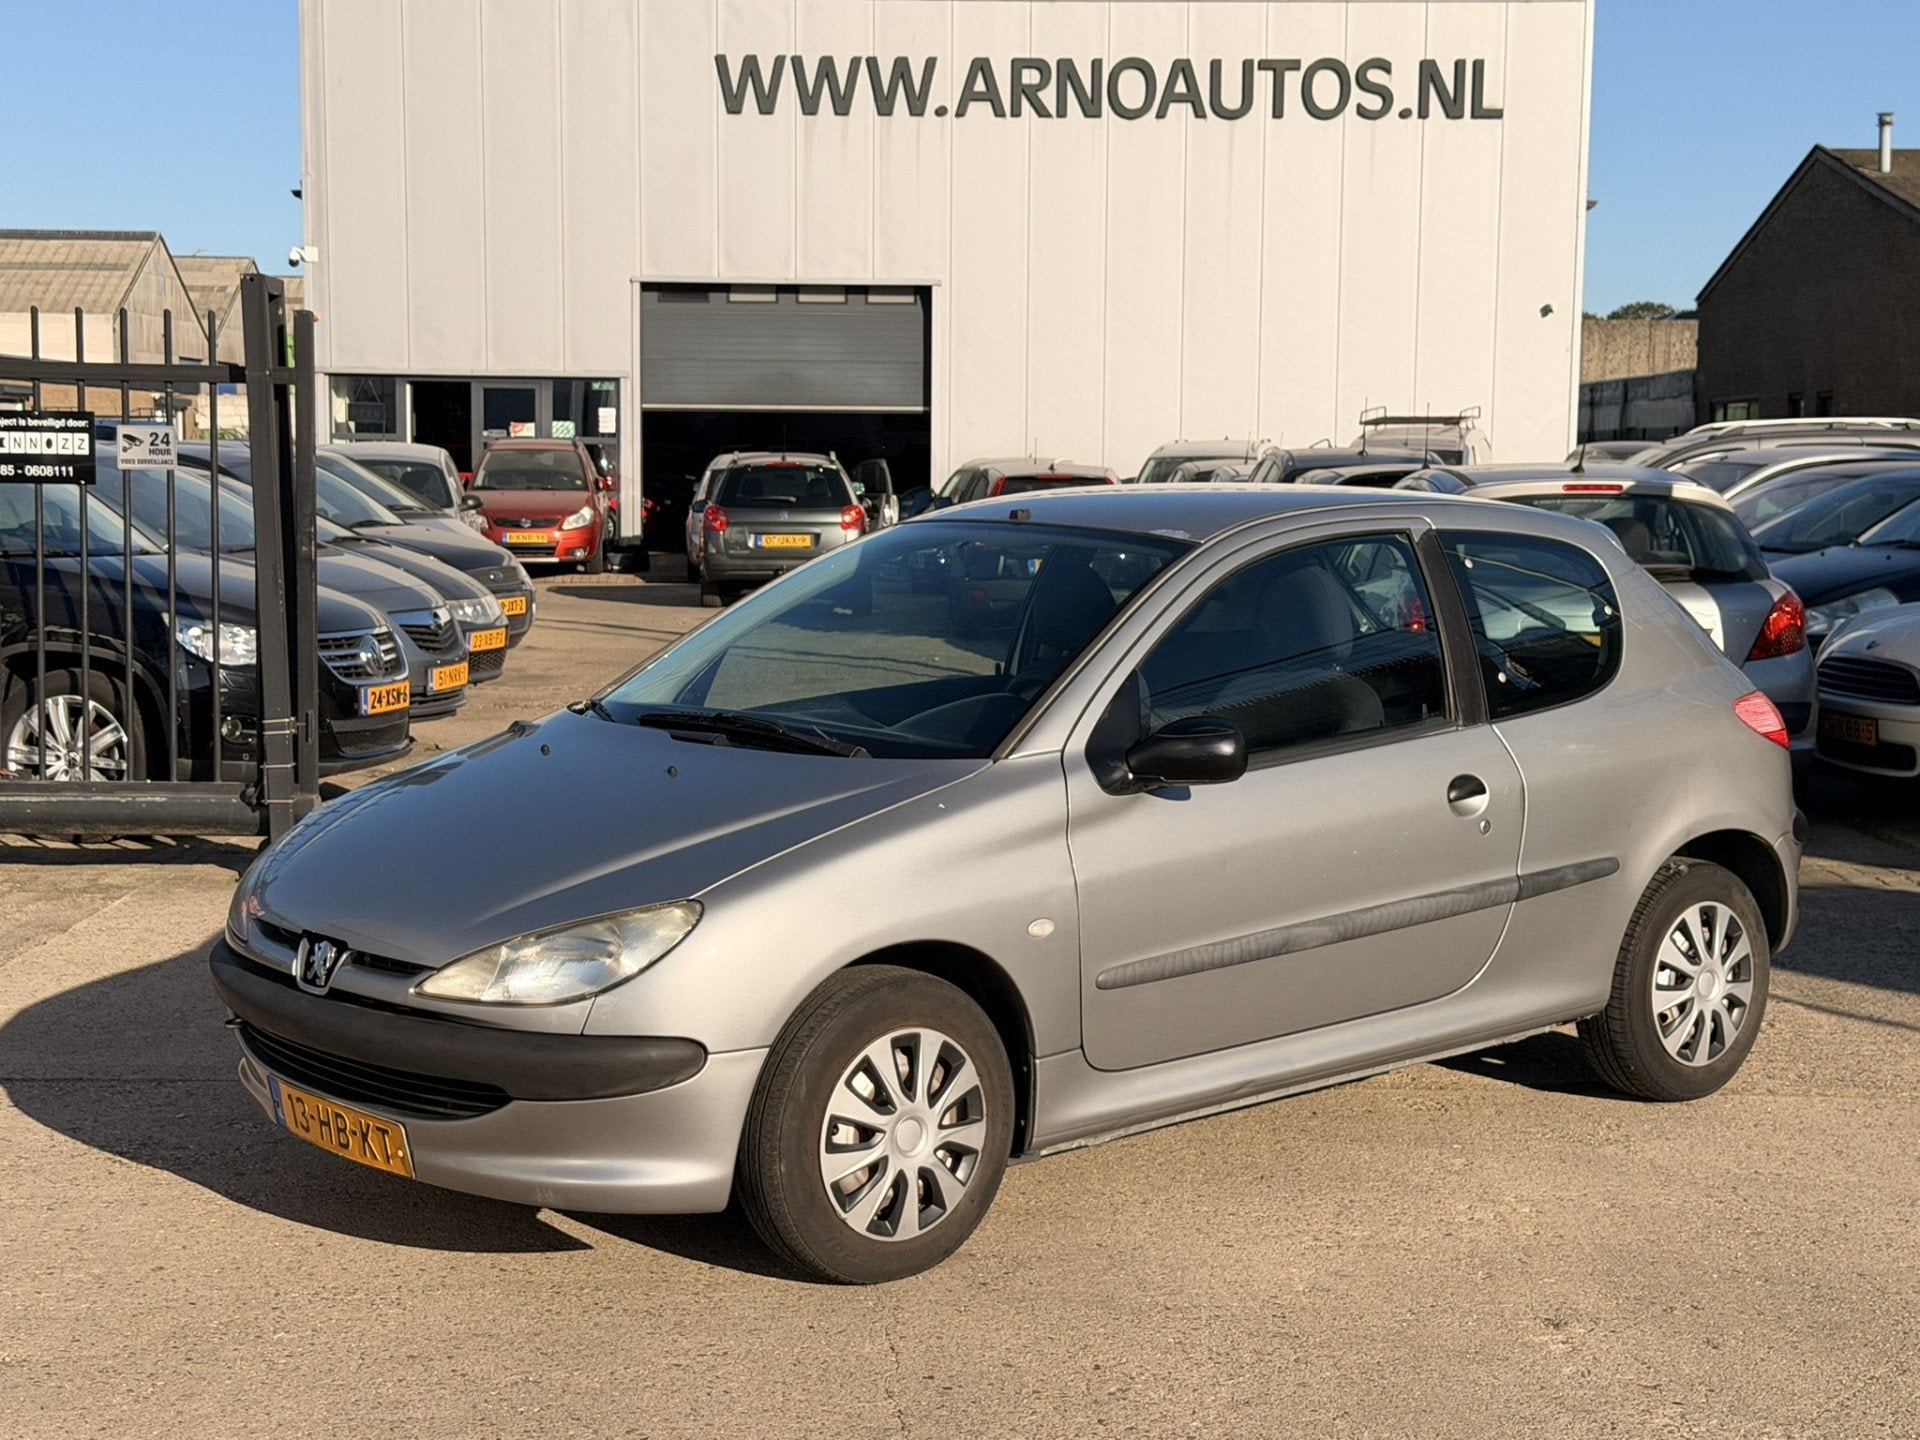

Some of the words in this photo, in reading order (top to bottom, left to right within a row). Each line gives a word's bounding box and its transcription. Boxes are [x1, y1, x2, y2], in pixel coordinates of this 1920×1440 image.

[715, 54, 1504, 120] WWW.ARNOAUTOS.NL
[67, 419, 89, 428] door:
[149, 432, 171, 446] 24
[149, 448, 171, 456] HOUR
[24, 465, 74, 477] 0608111
[287, 1093, 393, 1165] 13-HB-KT
